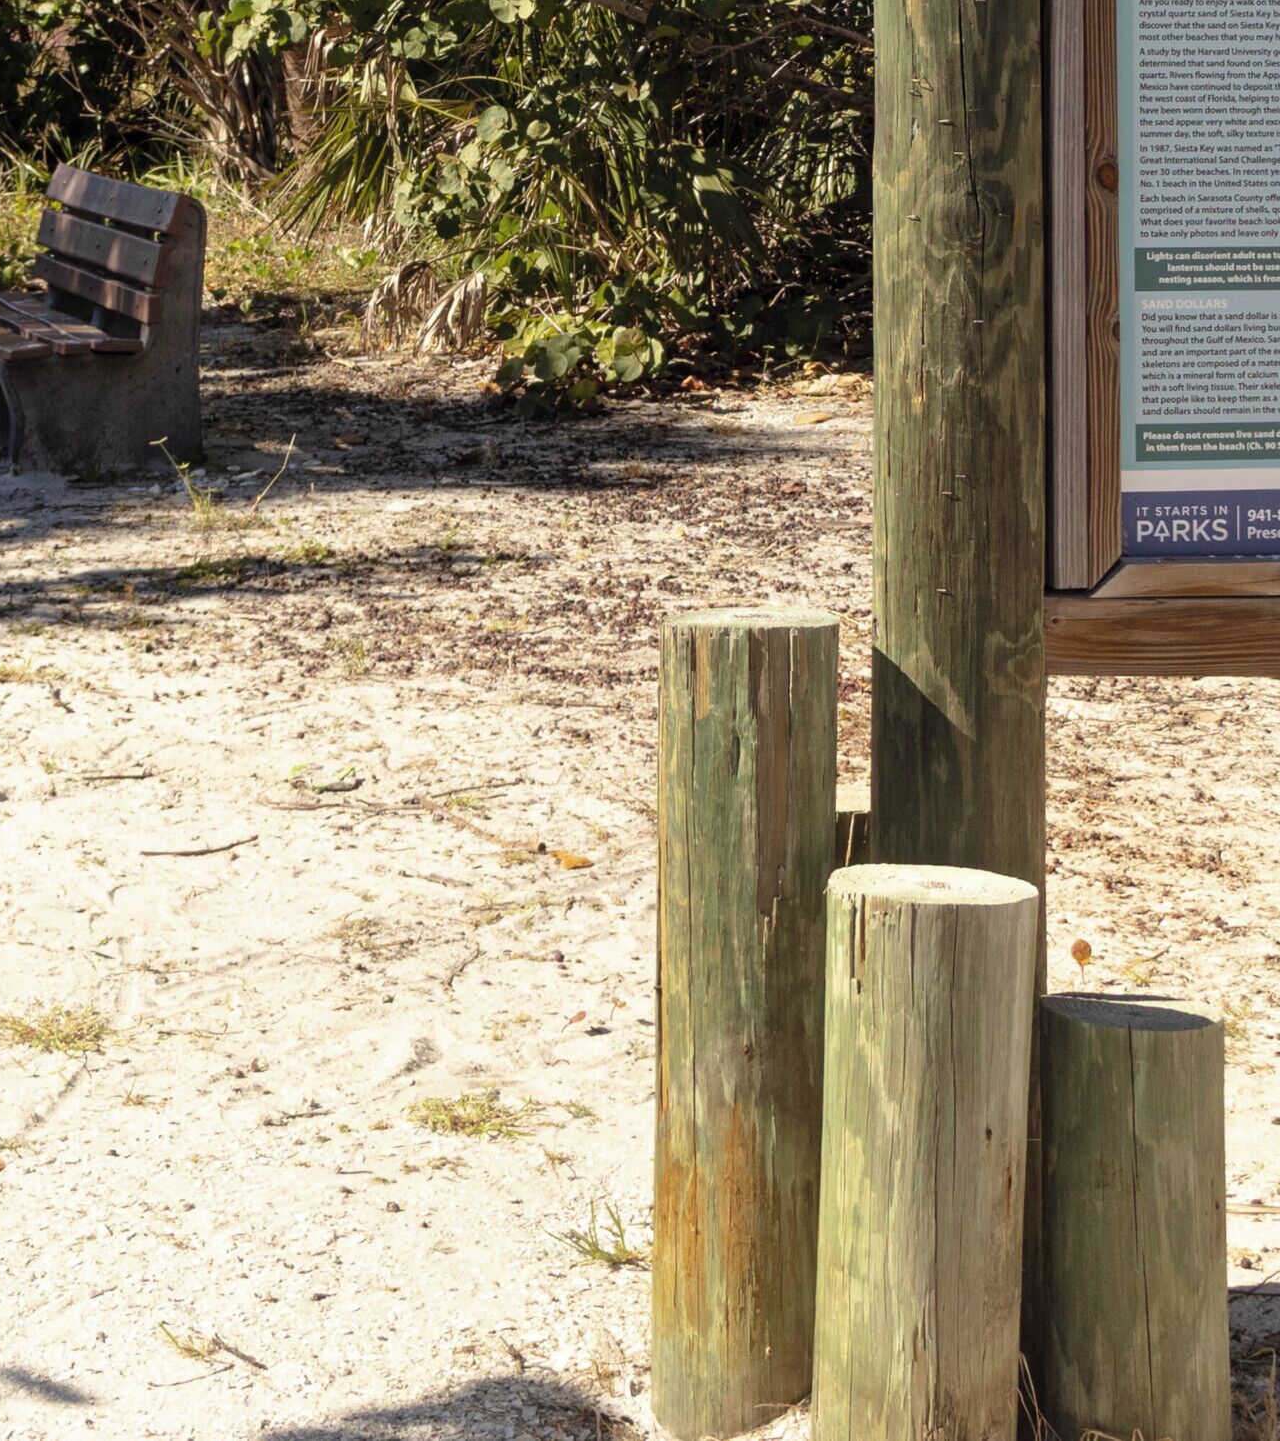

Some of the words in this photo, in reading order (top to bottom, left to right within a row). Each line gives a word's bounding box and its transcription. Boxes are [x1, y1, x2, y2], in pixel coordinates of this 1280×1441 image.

[1146, 251, 1173, 263] Lights
[1174, 253, 1190, 261] can
[1191, 251, 1231, 260] disorient
[1232, 251, 1255, 260] adult
[1167, 263, 1203, 272] lanterns
[1204, 263, 1234, 272] should
[1235, 262, 1251, 272] not
[1252, 262, 1263, 272] be
[1158, 275, 1191, 286] nesting
[1193, 277, 1225, 285] season,
[1227, 274, 1253, 284] which
[1254, 274, 1261, 284] is
[1142, 299, 1173, 310] SAND
[1175, 298, 1227, 310] DOLLARS
[1143, 431, 1171, 441] Please
[1172, 431, 1184, 440] do
[1185, 431, 1201, 440] not
[1202, 432, 1235, 440] remove
[1236, 430, 1252, 439] live
[1253, 430, 1275, 439] sand
[1146, 443, 1154, 452] in
[1156, 443, 1179, 452] them
[1180, 442, 1201, 452] from
[1203, 442, 1217, 452] the
[1218, 442, 1245, 451] beach
[1246, 442, 1263, 453] (Ch.
[1264, 441, 1276, 451] 90
[1136, 506, 1148, 517] IT
[1155, 505, 1207, 516] STARTS
[1213, 505, 1227, 516] IN
[1136, 518, 1227, 544] PARKS
